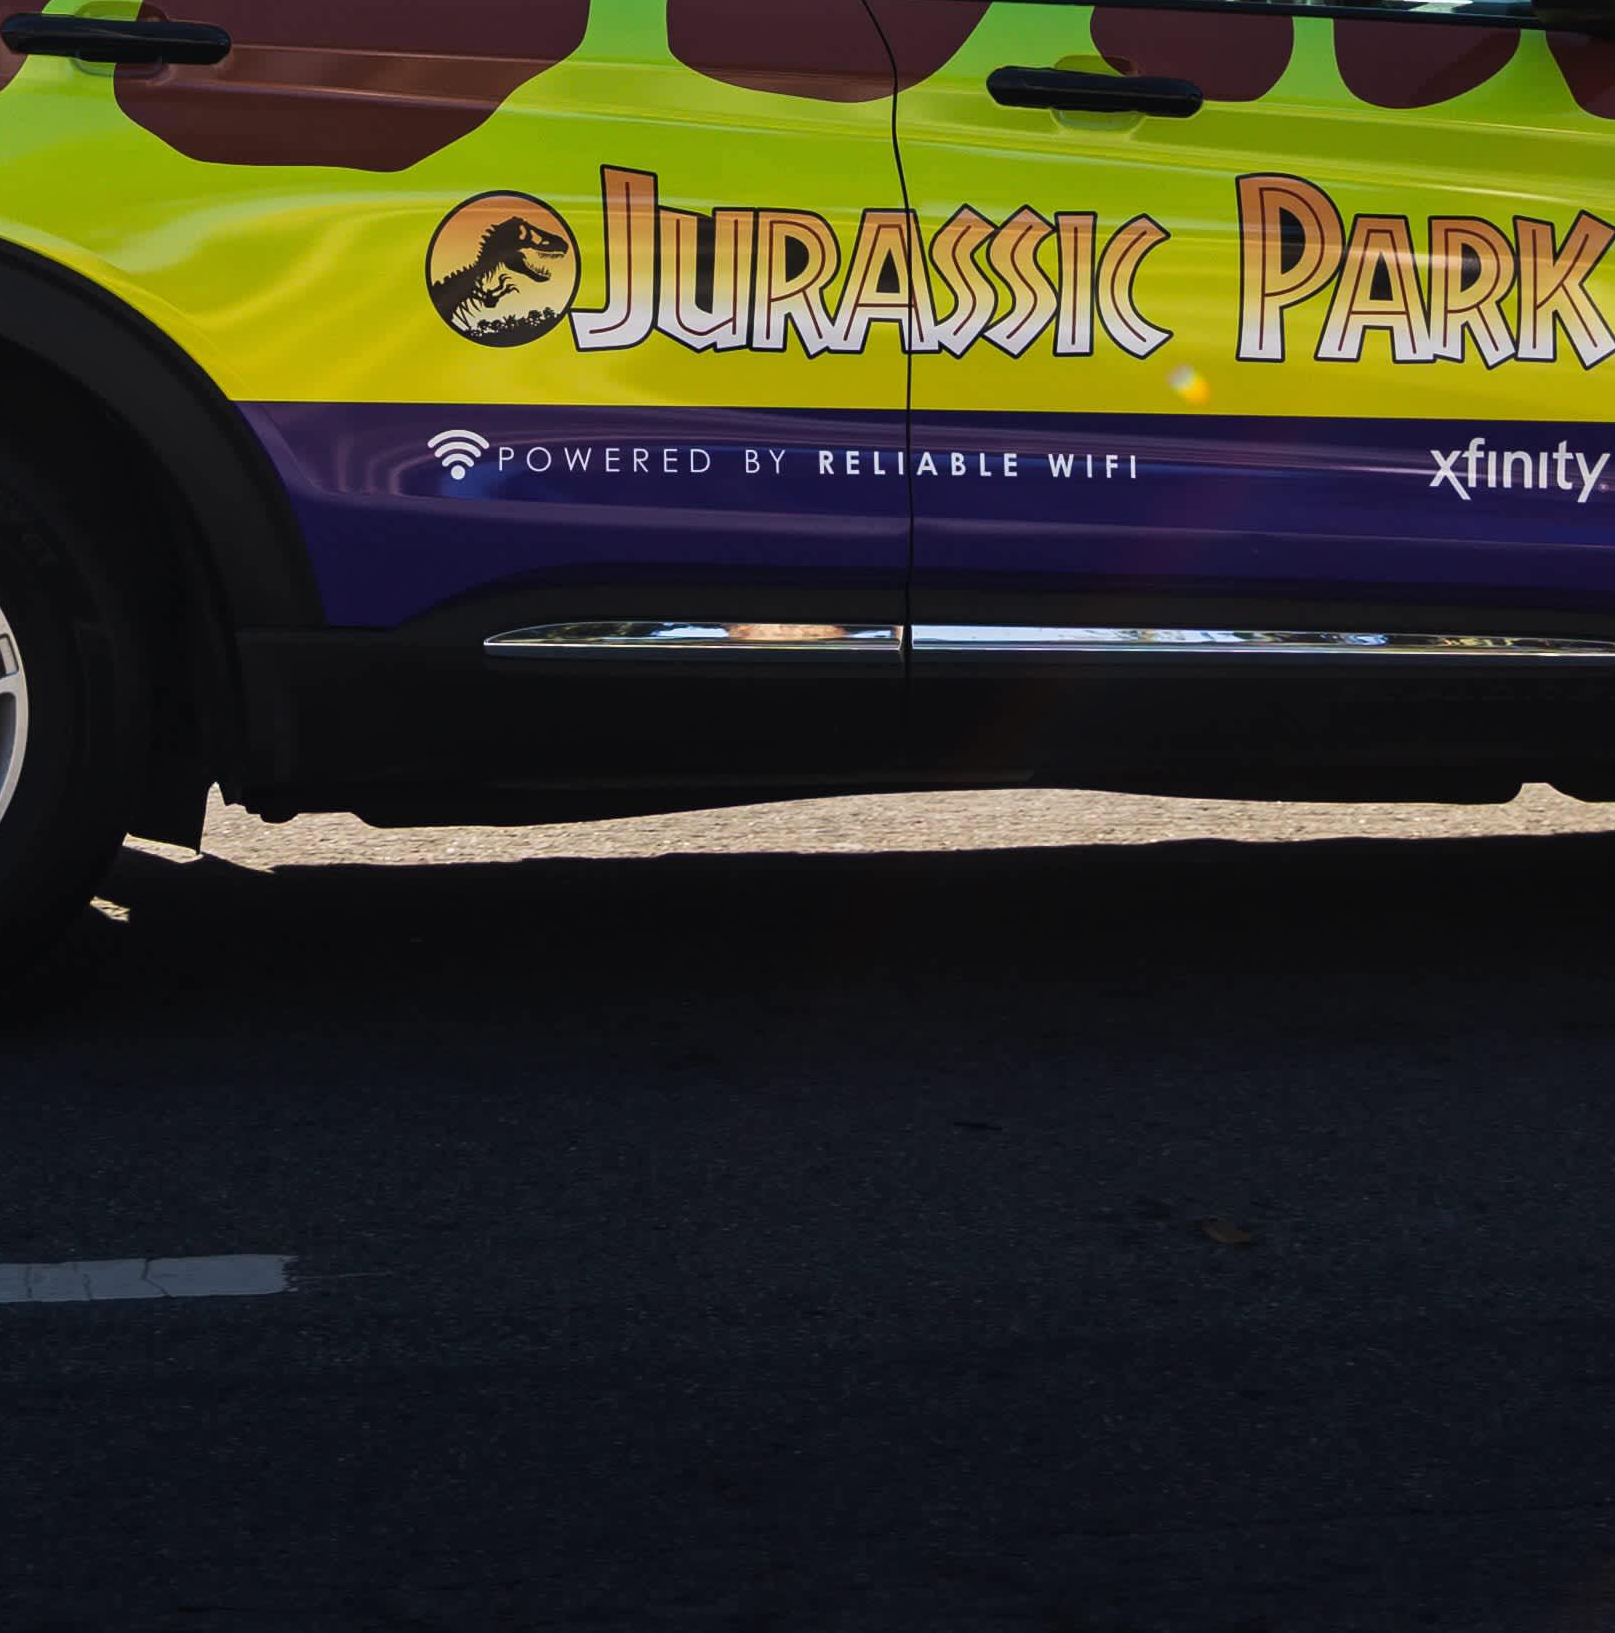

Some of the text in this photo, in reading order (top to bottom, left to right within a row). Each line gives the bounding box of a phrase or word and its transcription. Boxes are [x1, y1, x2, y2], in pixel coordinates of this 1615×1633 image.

[569, 164, 1173, 359] JURASSIC
[497, 445, 1137, 479] POWERED BY RELIABLE WIFI
[1429, 437, 1611, 503] xfinity
